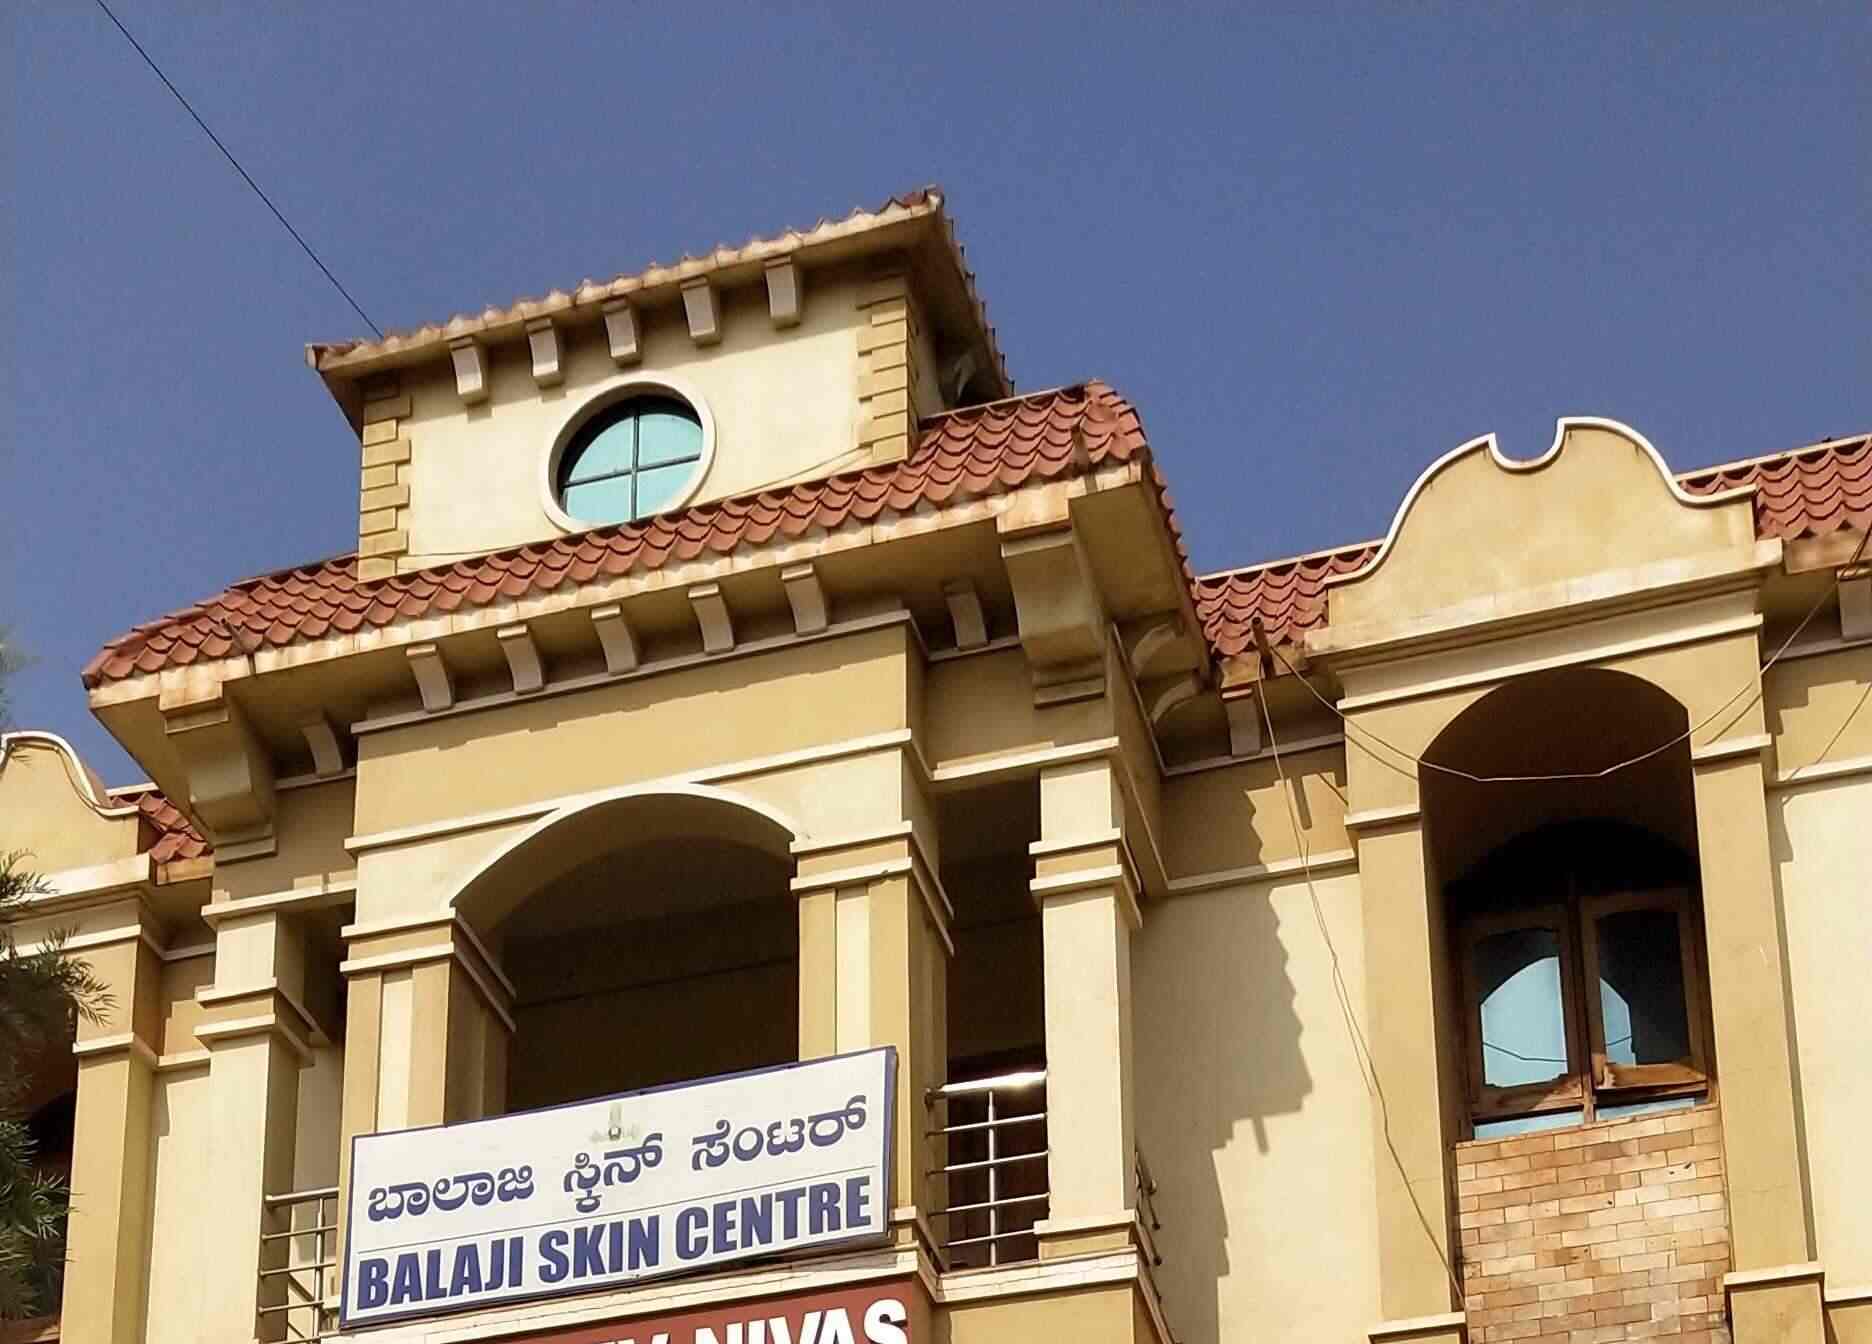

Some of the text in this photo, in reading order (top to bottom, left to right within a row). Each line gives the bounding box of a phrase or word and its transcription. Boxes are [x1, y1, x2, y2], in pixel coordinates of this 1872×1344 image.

[367, 1095, 868, 1222] ಬಾಲಾಜಿ ಸ್ಕಿನ್ ಸೆಂಟರ್
[356, 1175, 873, 1310] BALAJI SKIN CENTRE
